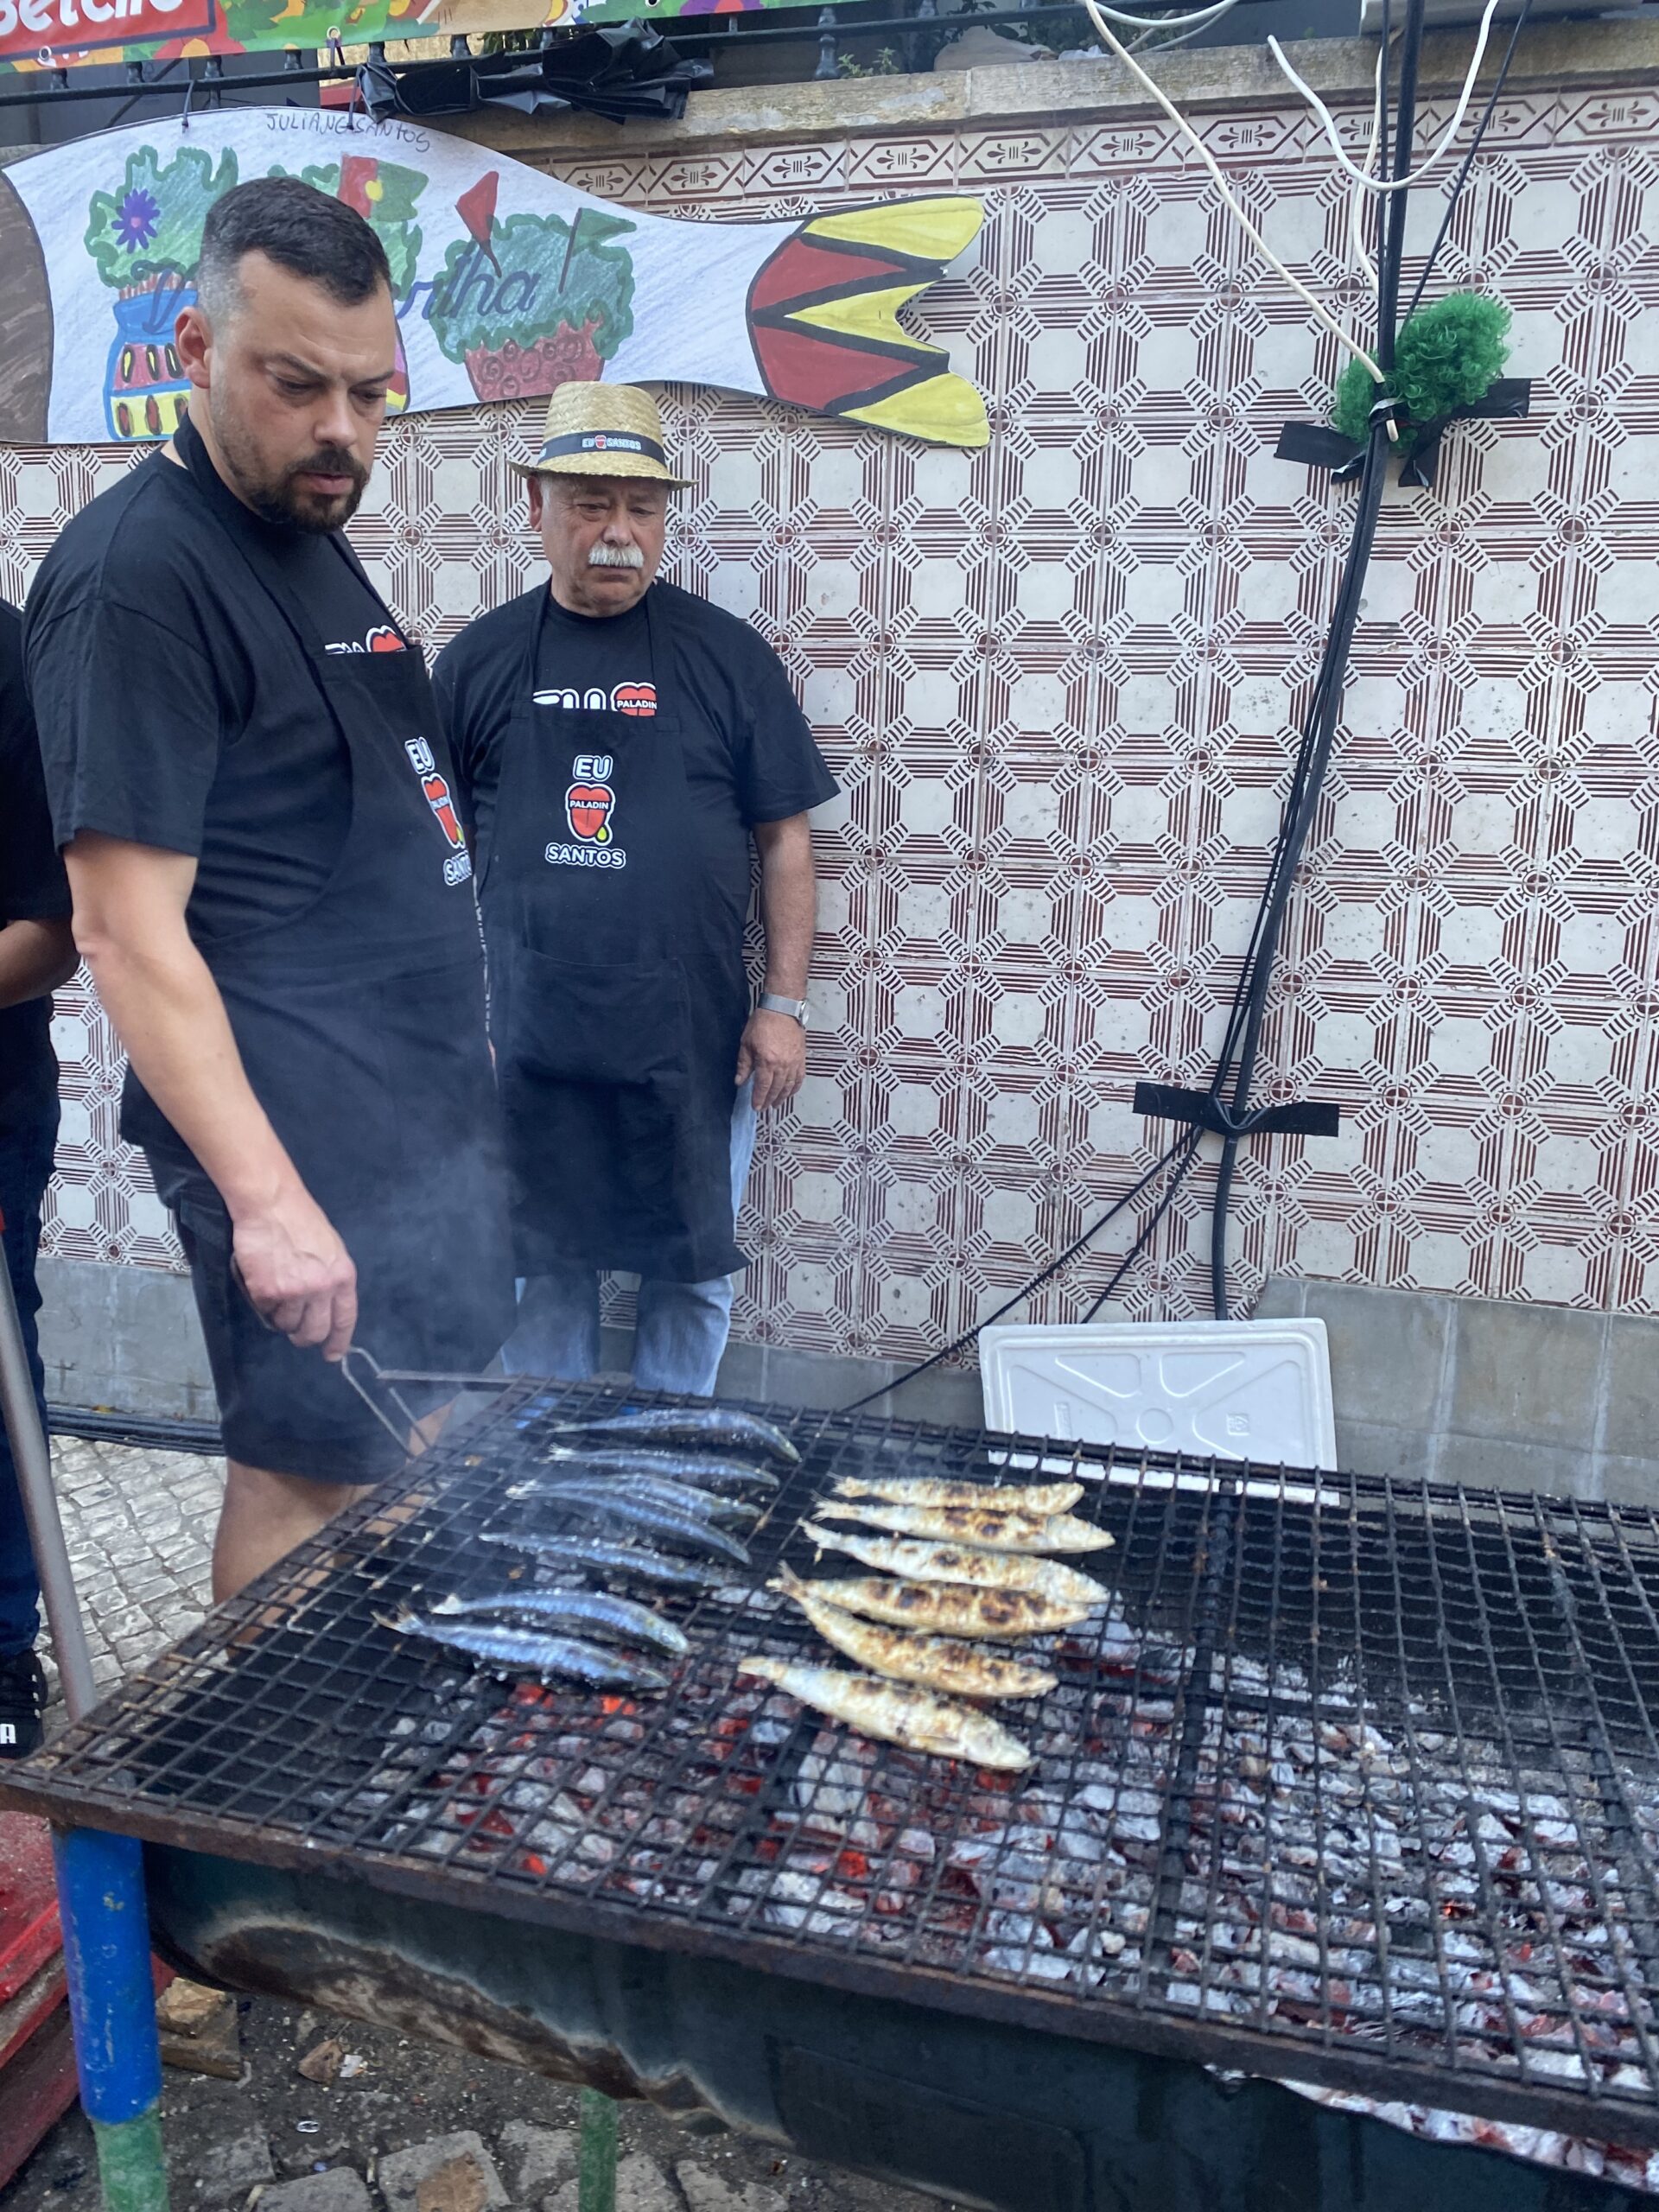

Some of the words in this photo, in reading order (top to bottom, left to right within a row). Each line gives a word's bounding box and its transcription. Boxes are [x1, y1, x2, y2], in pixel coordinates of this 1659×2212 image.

[607, 437, 641, 450] SANTOS
[616, 699, 658, 710] PALADIN
[406, 738, 434, 772] EU
[574, 756, 612, 780] EU
[569, 800, 610, 810] PALADIN
[546, 843, 625, 868] SANTOS
